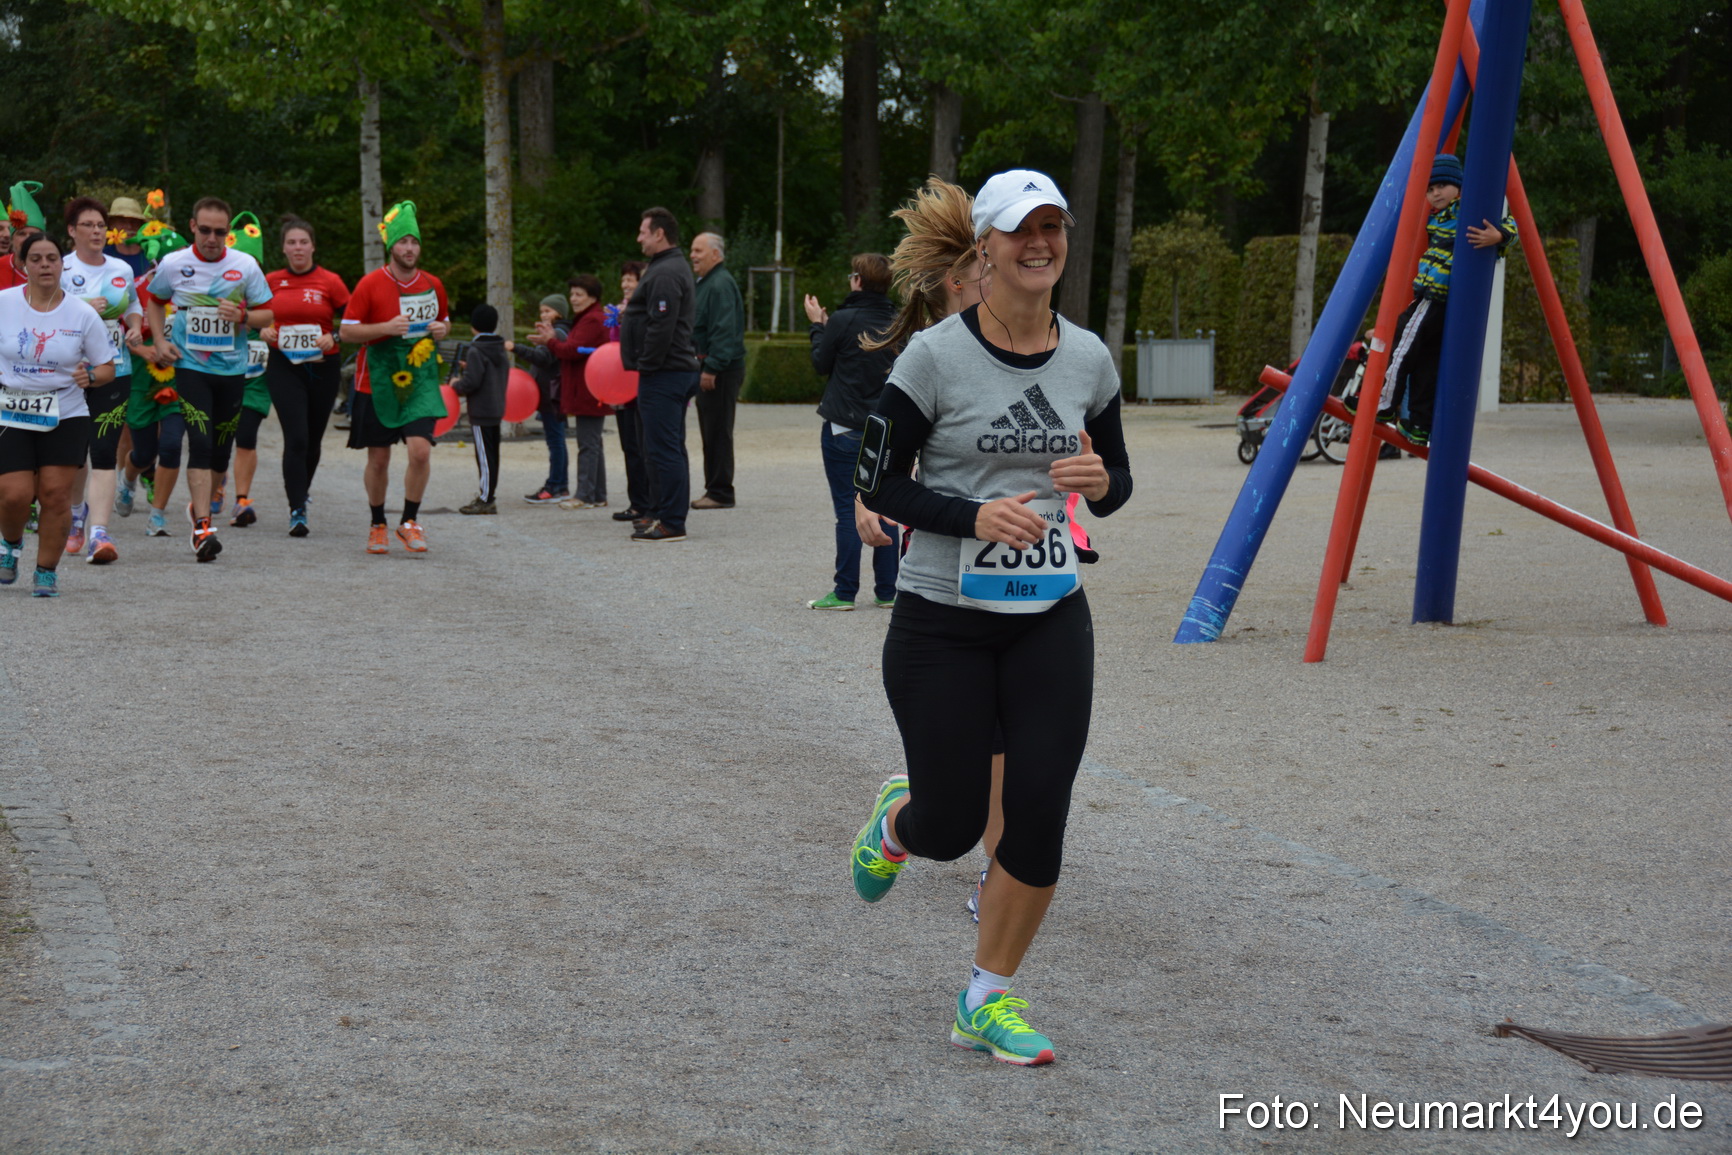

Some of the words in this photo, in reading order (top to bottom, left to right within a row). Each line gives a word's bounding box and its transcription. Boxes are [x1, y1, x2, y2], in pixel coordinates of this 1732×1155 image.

[406, 302, 436, 322] 2423
[192, 317, 230, 334] 3018
[283, 334, 318, 349] 2785
[5, 396, 53, 413] 3047
[976, 428, 1078, 454] adidas
[974, 527, 1067, 570] 2336
[1004, 580, 1038, 597] Alex
